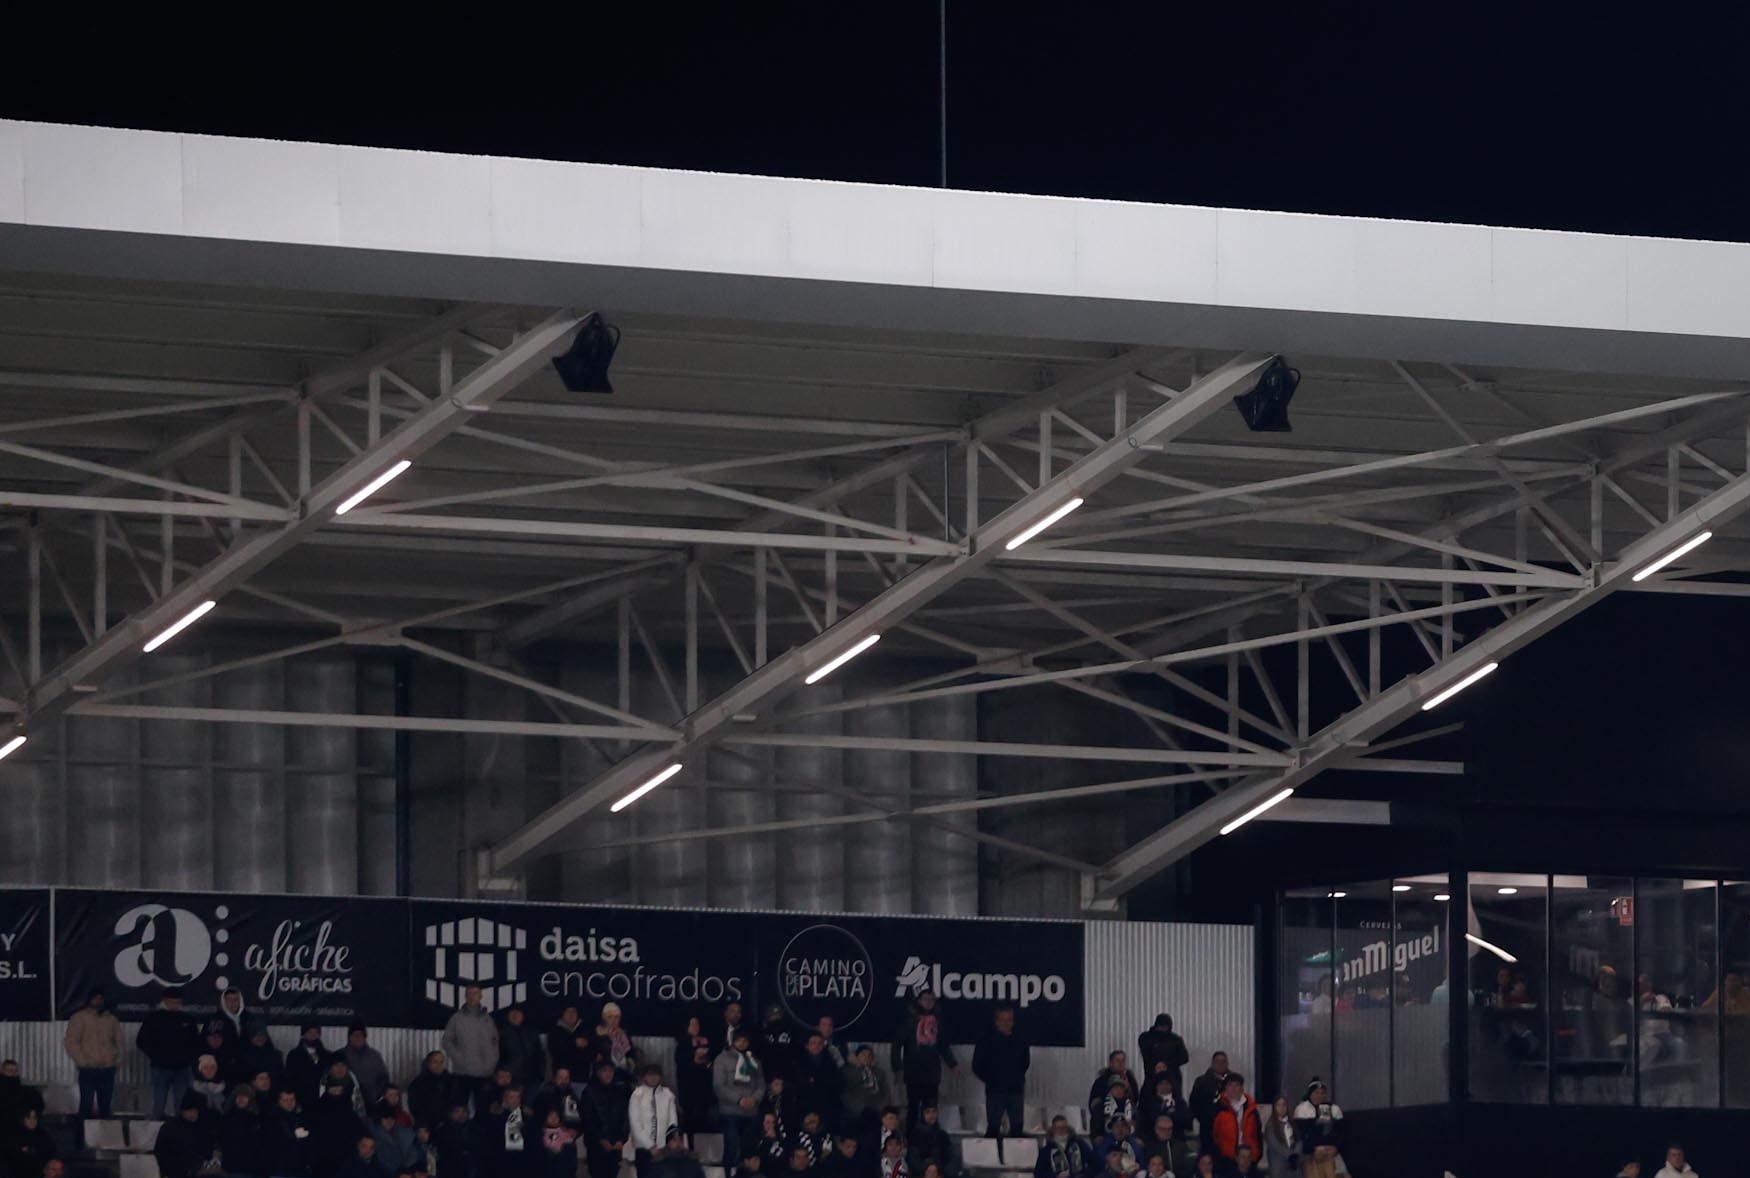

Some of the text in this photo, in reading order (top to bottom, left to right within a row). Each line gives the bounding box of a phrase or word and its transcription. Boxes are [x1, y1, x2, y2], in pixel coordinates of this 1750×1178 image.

[0, 933, 17, 951] Y
[539, 926, 641, 963] daisa
[244, 919, 353, 1000] afiche
[785, 957, 867, 976] CAMINO
[279, 976, 353, 993] GRÁFICAS
[539, 964, 743, 1002] encofrados
[799, 975, 865, 998] PLATA
[894, 955, 1066, 1009] Alcampo
